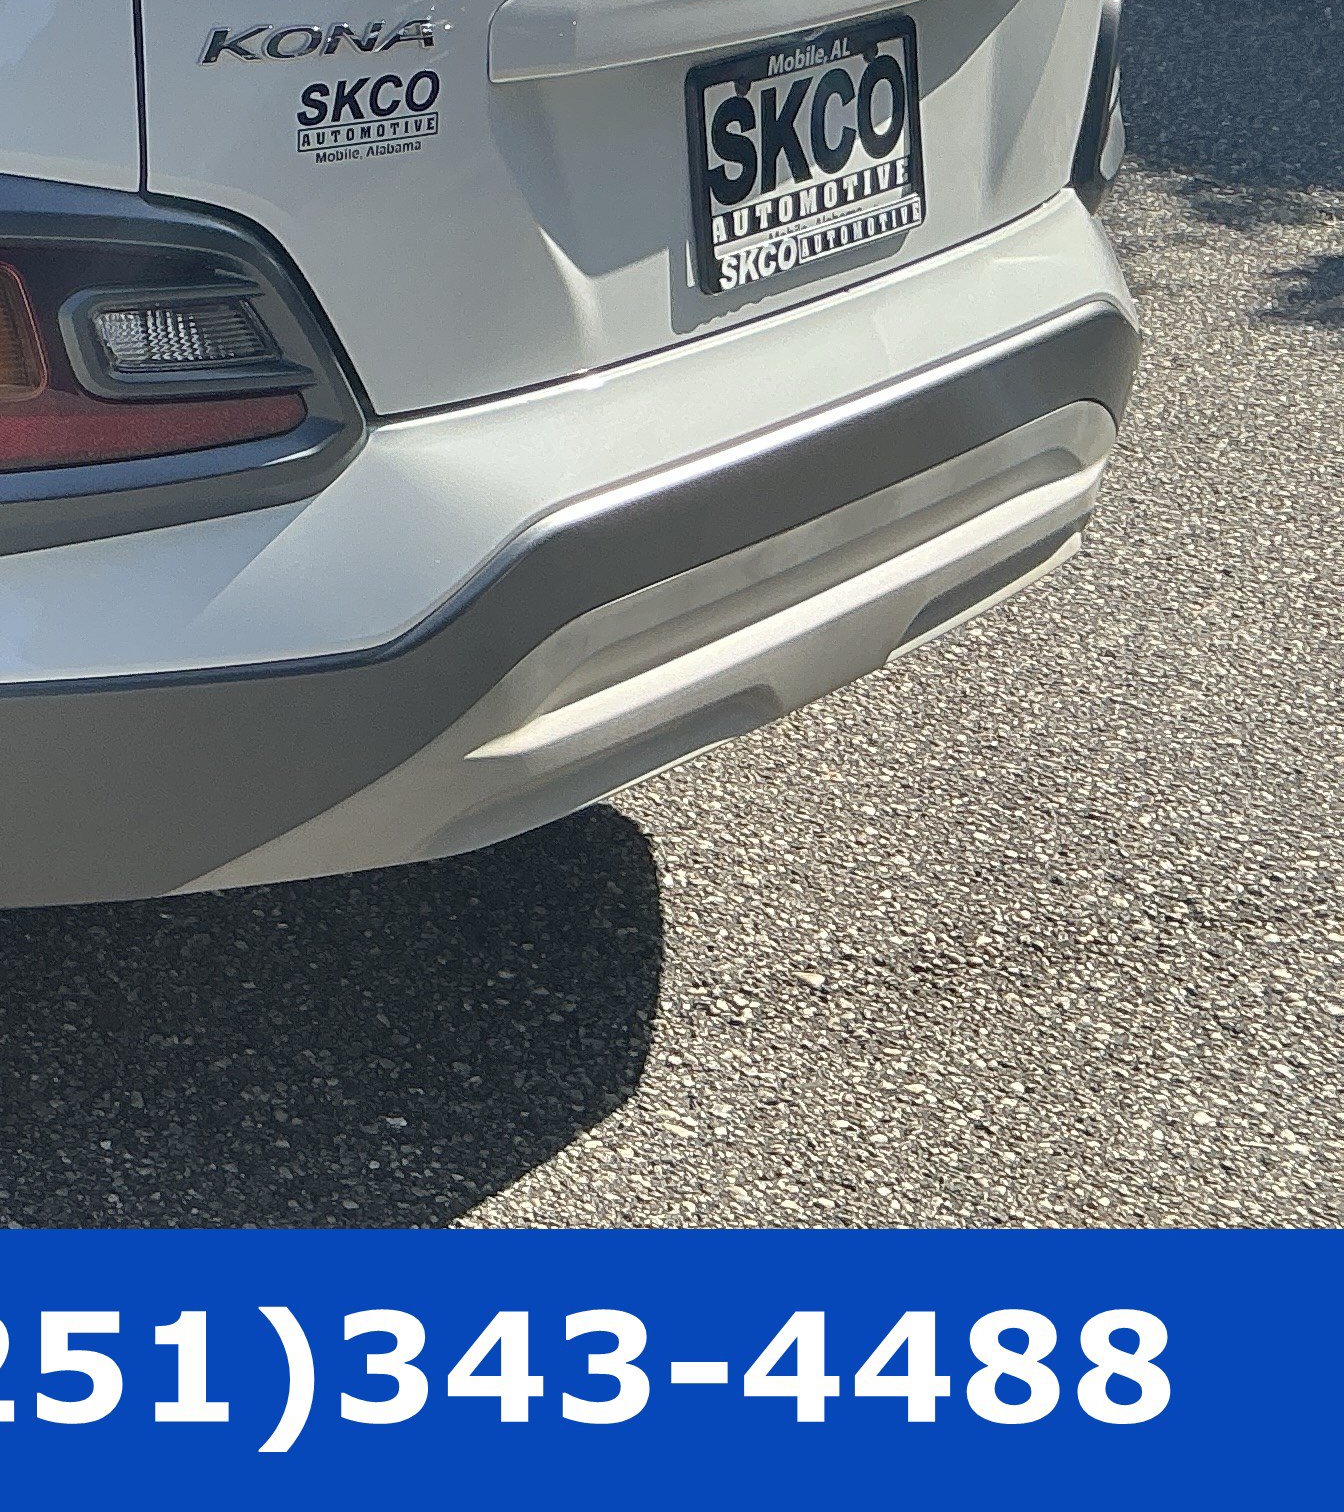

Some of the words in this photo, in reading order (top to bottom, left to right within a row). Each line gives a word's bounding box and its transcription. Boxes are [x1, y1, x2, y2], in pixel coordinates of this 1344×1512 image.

[198, 19, 435, 66] KONA
[768, 44, 829, 77] Mobile,
[829, 37, 851, 59] AL
[296, 69, 441, 127] SKCO
[301, 116, 436, 148] AUTOMOTIVE
[315, 148, 364, 164] Mobile,
[365, 140, 422, 159] Alabama
[702, 53, 906, 206] SKCO
[712, 158, 908, 245] AUTOMOTIVE
[718, 236, 799, 291] SKCO
[800, 198, 921, 259] AUTOMOTIVE
